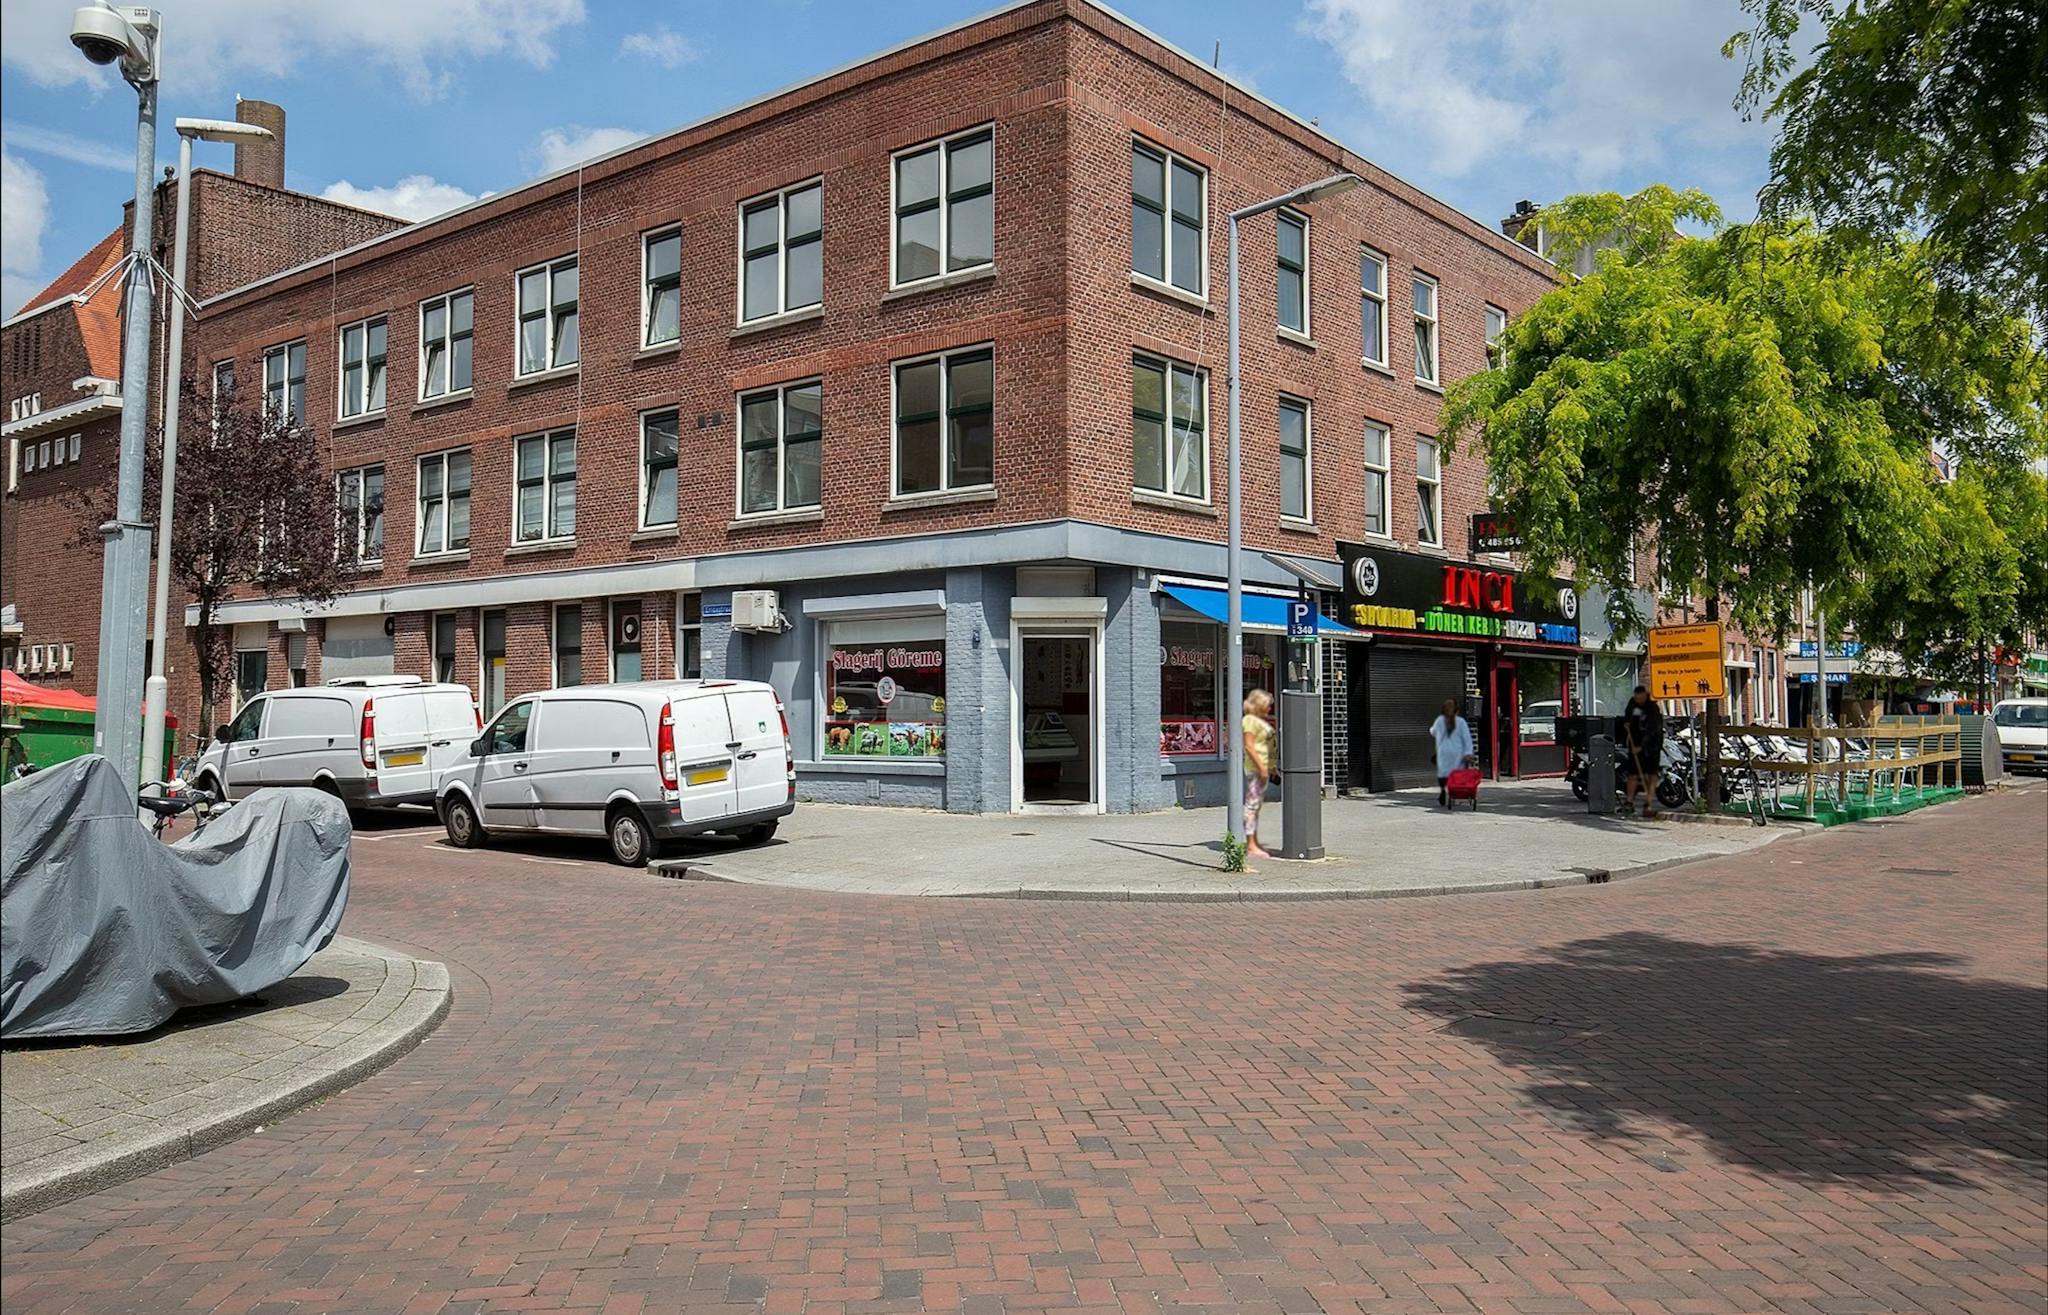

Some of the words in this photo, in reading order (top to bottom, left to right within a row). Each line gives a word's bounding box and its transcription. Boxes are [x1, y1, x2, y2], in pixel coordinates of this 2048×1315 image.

[1294, 604, 1309, 623] P
[1425, 606, 1464, 633] DÖNER
[1465, 615, 1501, 636] KEBAB
[1296, 625, 1313, 634] 340
[832, 649, 885, 673] Slagerij
[887, 648, 942, 669] Göreme
[1169, 645, 1215, 671] Slagerij
